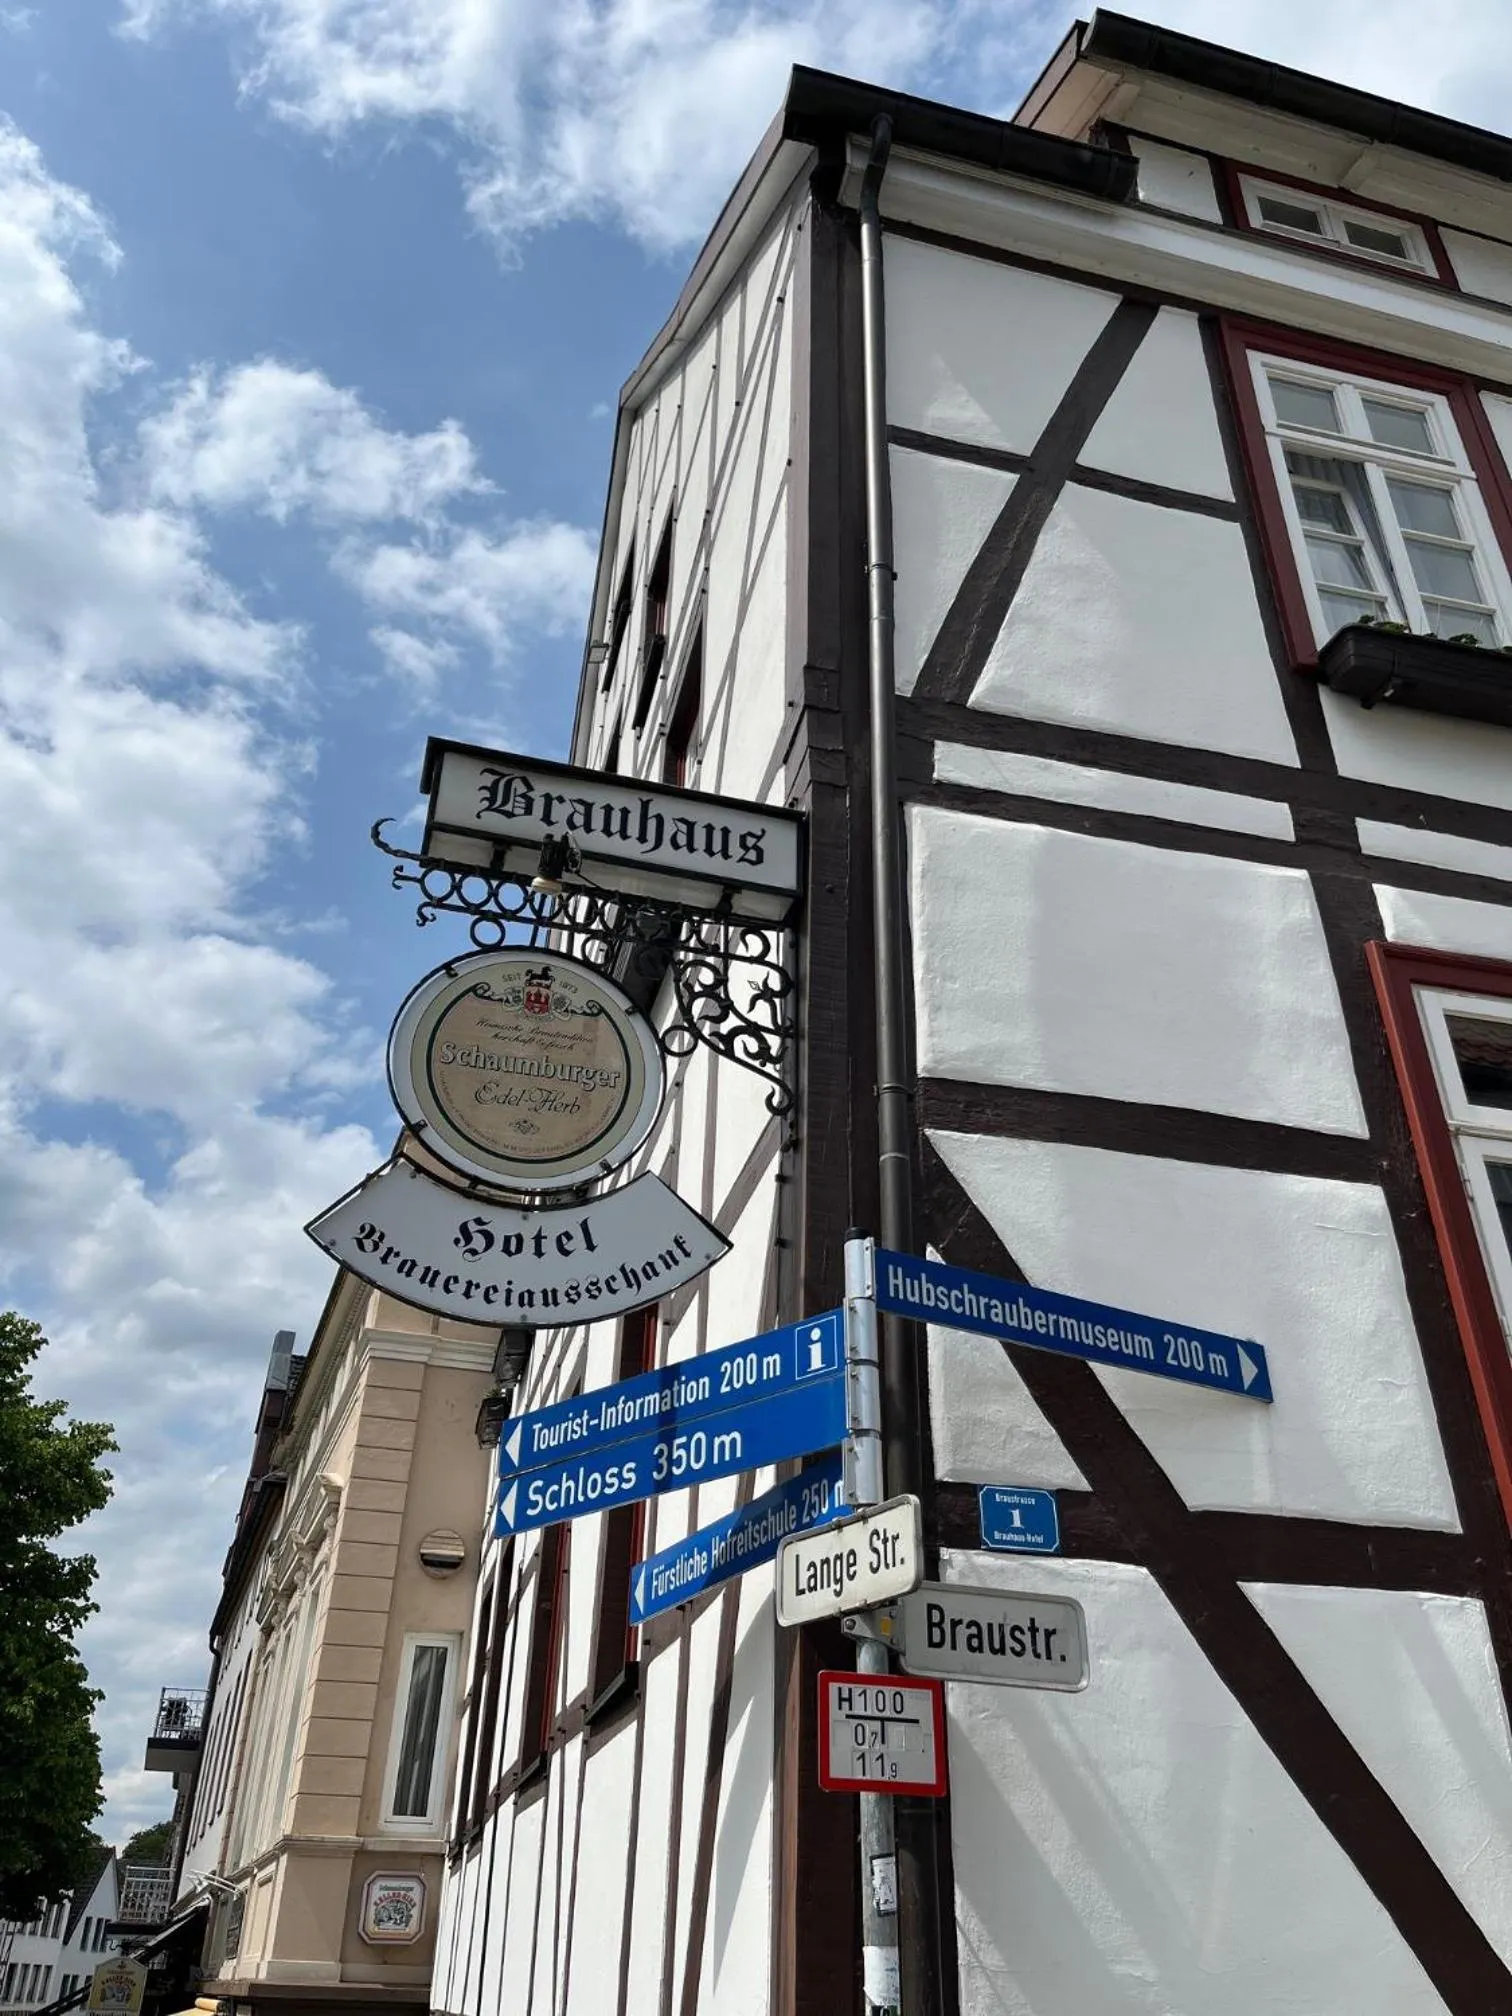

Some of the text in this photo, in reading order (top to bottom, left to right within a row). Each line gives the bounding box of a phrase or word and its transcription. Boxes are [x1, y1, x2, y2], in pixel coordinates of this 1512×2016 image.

[476, 767, 767, 868] Brauhaus
[440, 1040, 621, 1092] Schaumburger
[351, 1222, 694, 1308] Brauereiausschank
[453, 1216, 600, 1262] Hotel
[887, 1263, 1229, 1378] Hubschraubermuseum 200 m
[532, 1374, 710, 1452] Tourist-Information
[720, 1352, 756, 1393] 200
[763, 1351, 781, 1380] m
[526, 1429, 742, 1516] Schloss 350 m
[651, 1547, 708, 1601] Fürstliche
[711, 1504, 797, 1568] Hofreitschule
[801, 1479, 829, 1524] 250
[1010, 1508, 1024, 1528] 1
[795, 1529, 905, 1598] Lange Str.
[926, 1602, 1067, 1662] Braustr.
